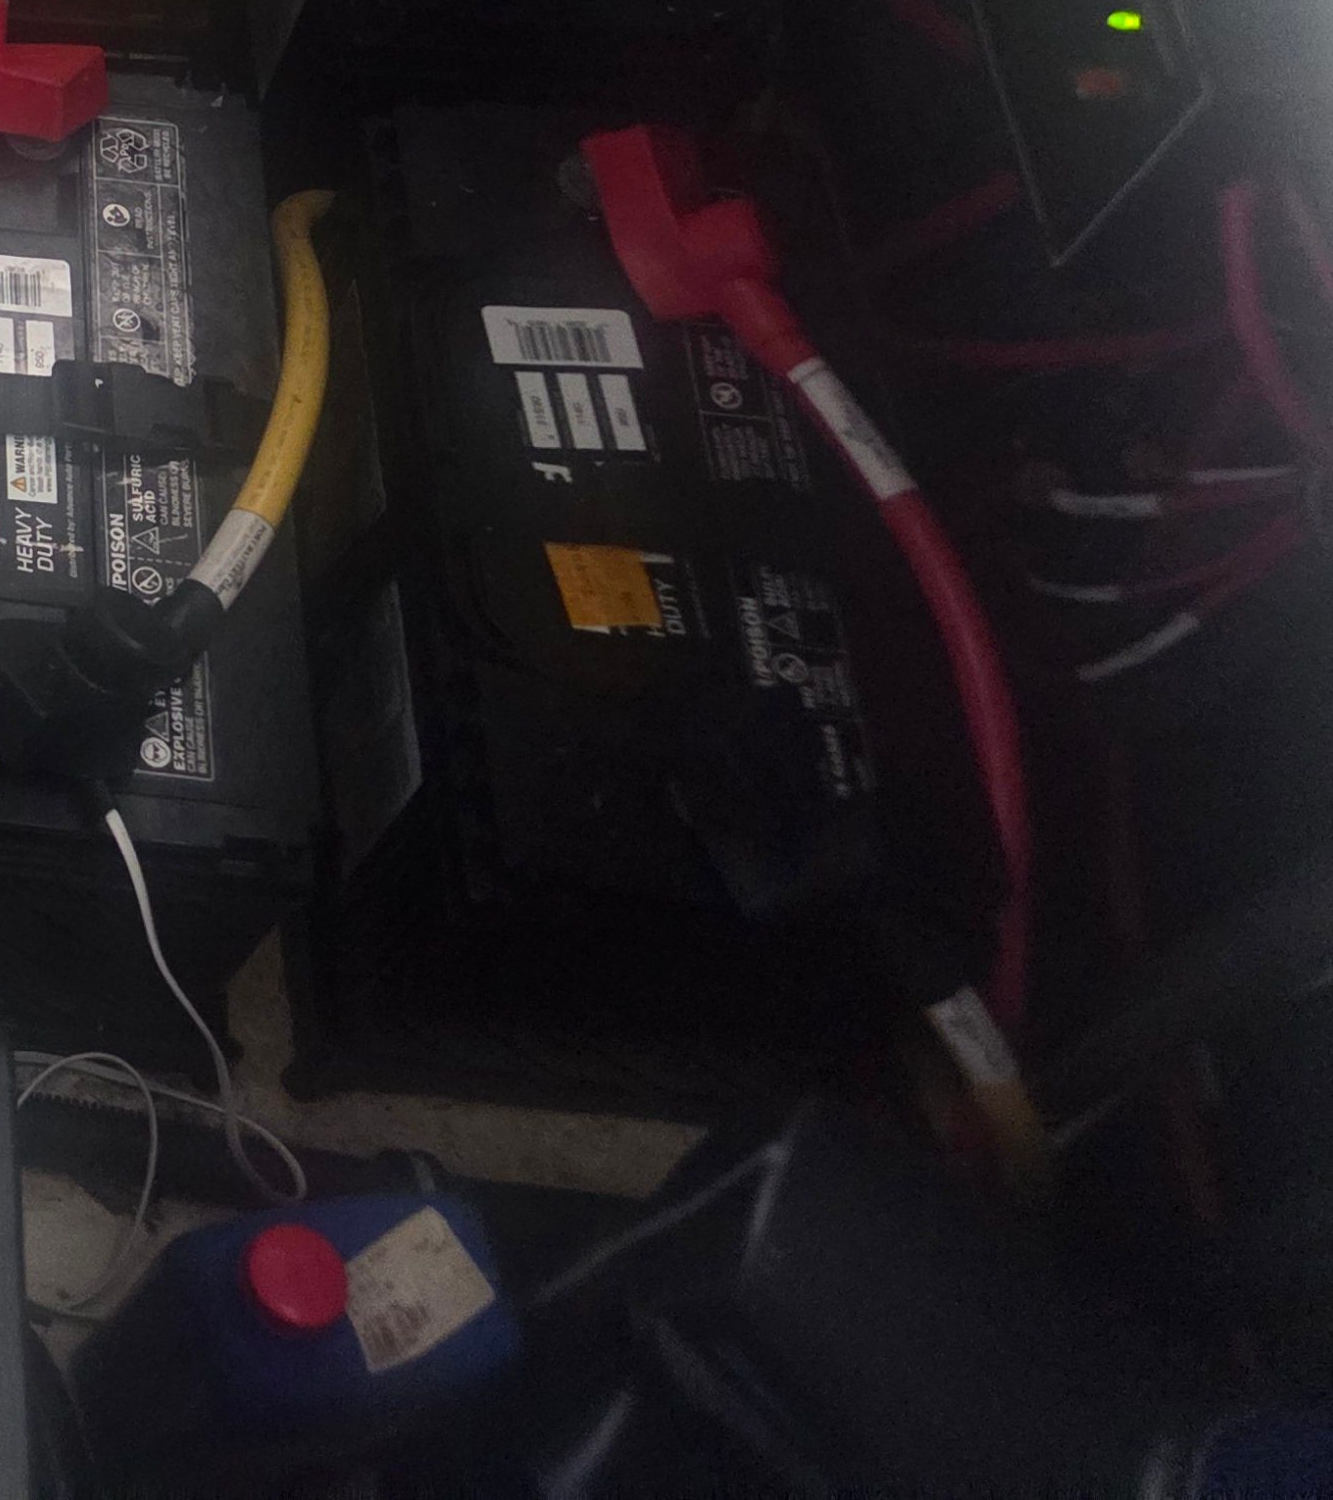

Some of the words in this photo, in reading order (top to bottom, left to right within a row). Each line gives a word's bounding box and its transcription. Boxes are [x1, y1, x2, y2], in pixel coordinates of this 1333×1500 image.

[129, 453, 144, 521] SULFURIC
[143, 489, 156, 524] ACID
[159, 504, 168, 525] CAN
[14, 505, 34, 573] HEAVY
[34, 514, 55, 573] DUTY
[653, 576, 687, 635] DUTY
[169, 685, 186, 771] EXPLOSIVE
[184, 715, 196, 750] CAUSE
[186, 750, 197, 772] CAN
